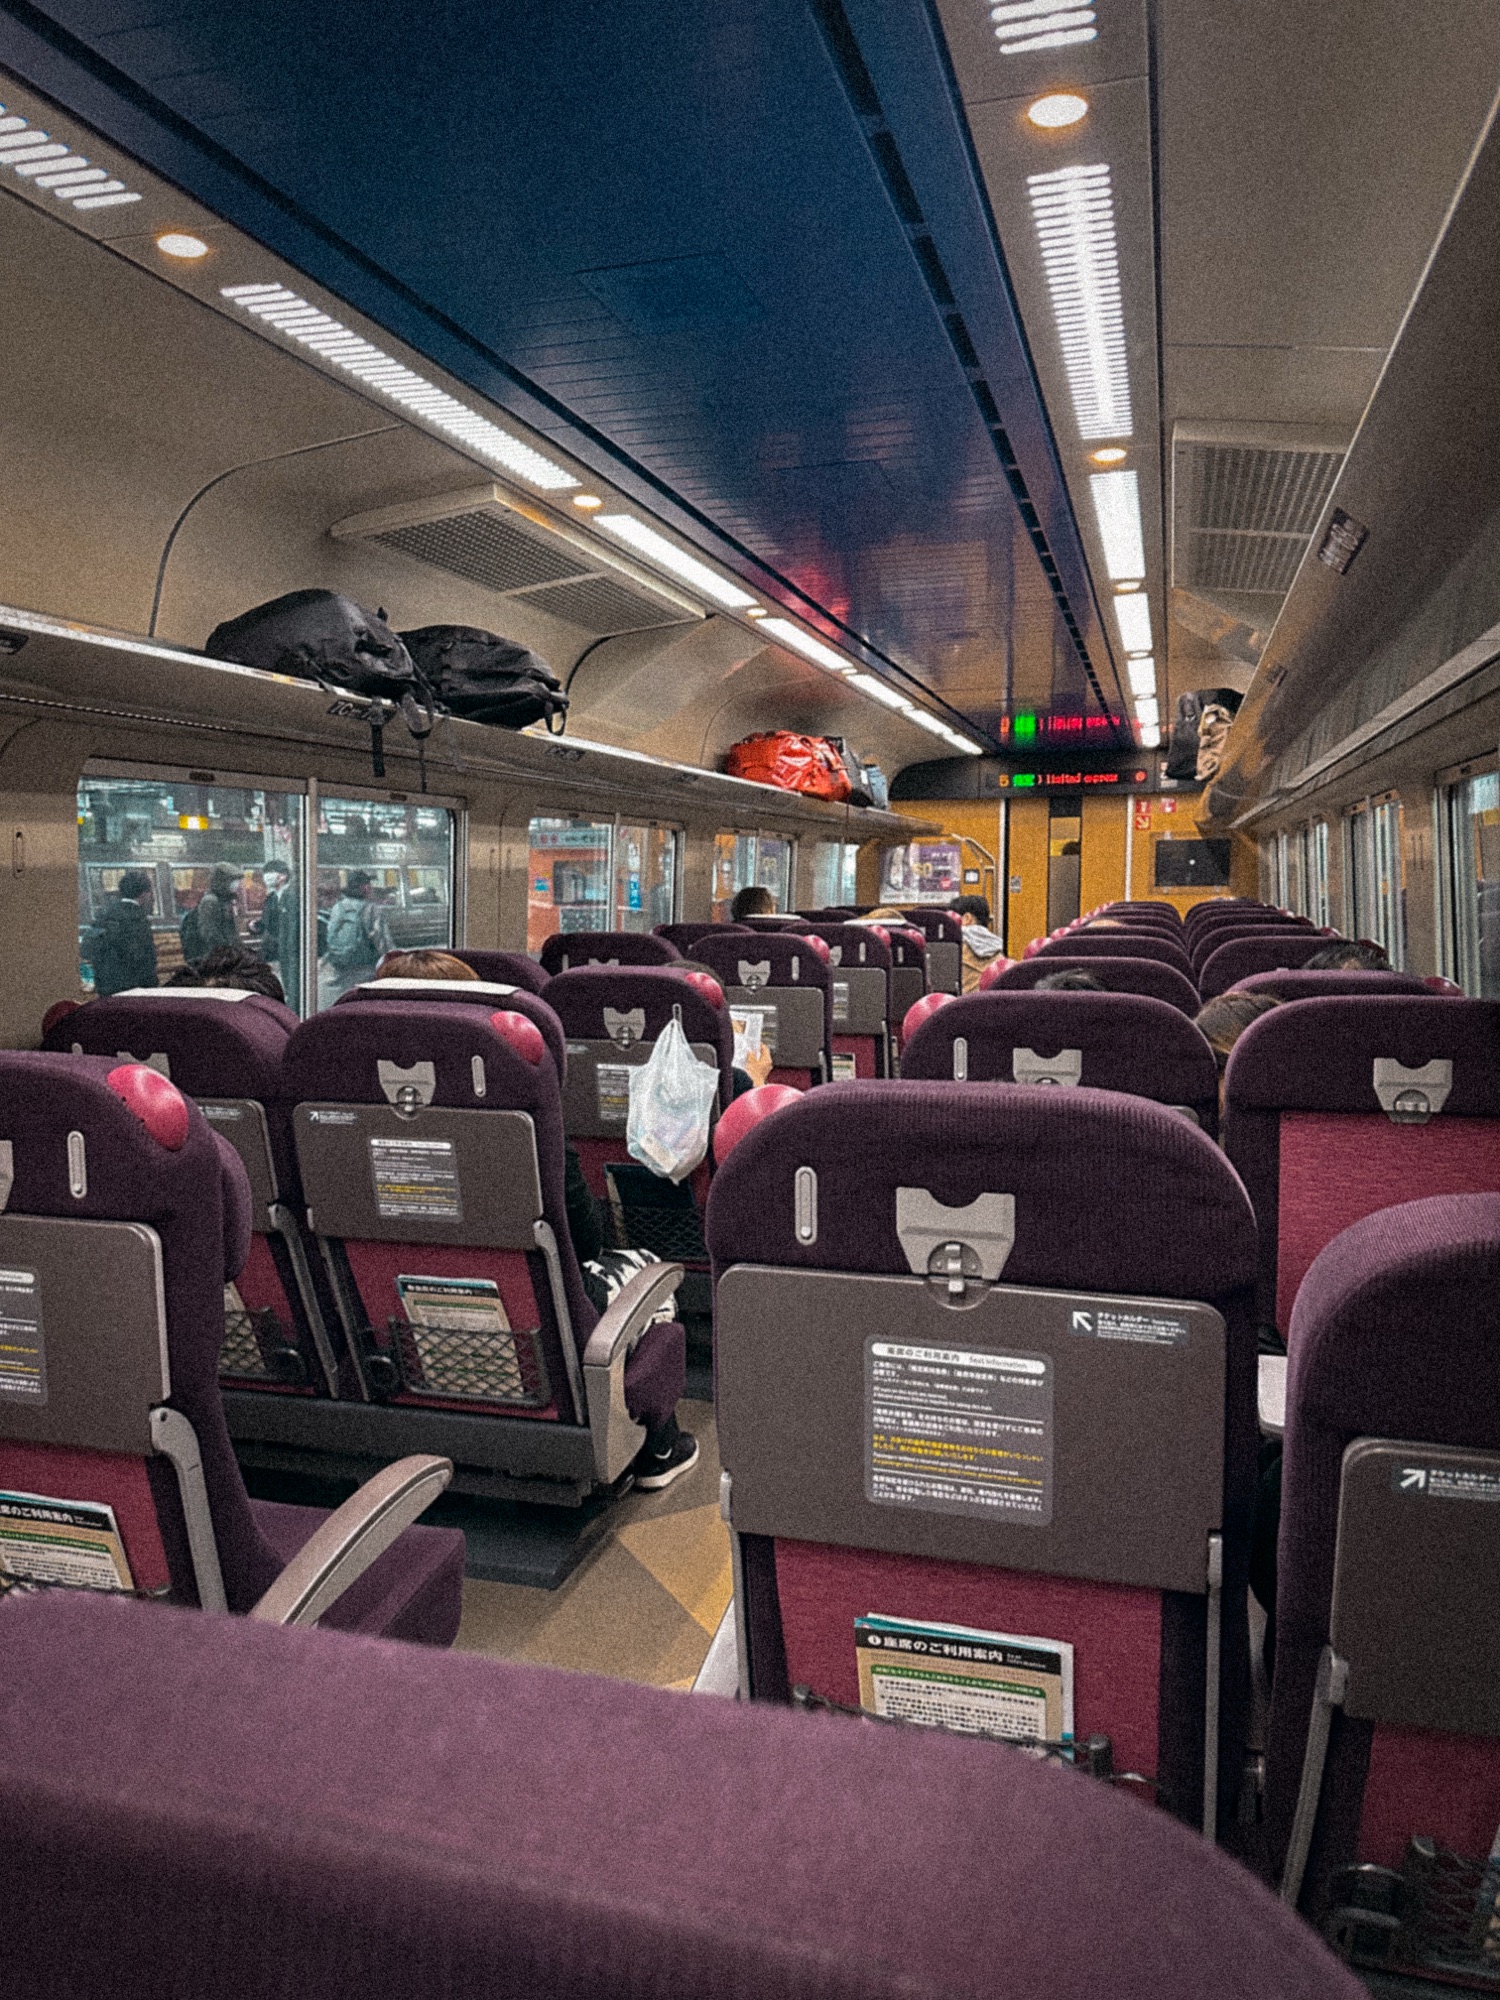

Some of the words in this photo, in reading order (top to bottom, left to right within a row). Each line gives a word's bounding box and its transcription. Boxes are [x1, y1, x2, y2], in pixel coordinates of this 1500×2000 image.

[883, 1636, 1003, 1662] 座席のご利用案内
